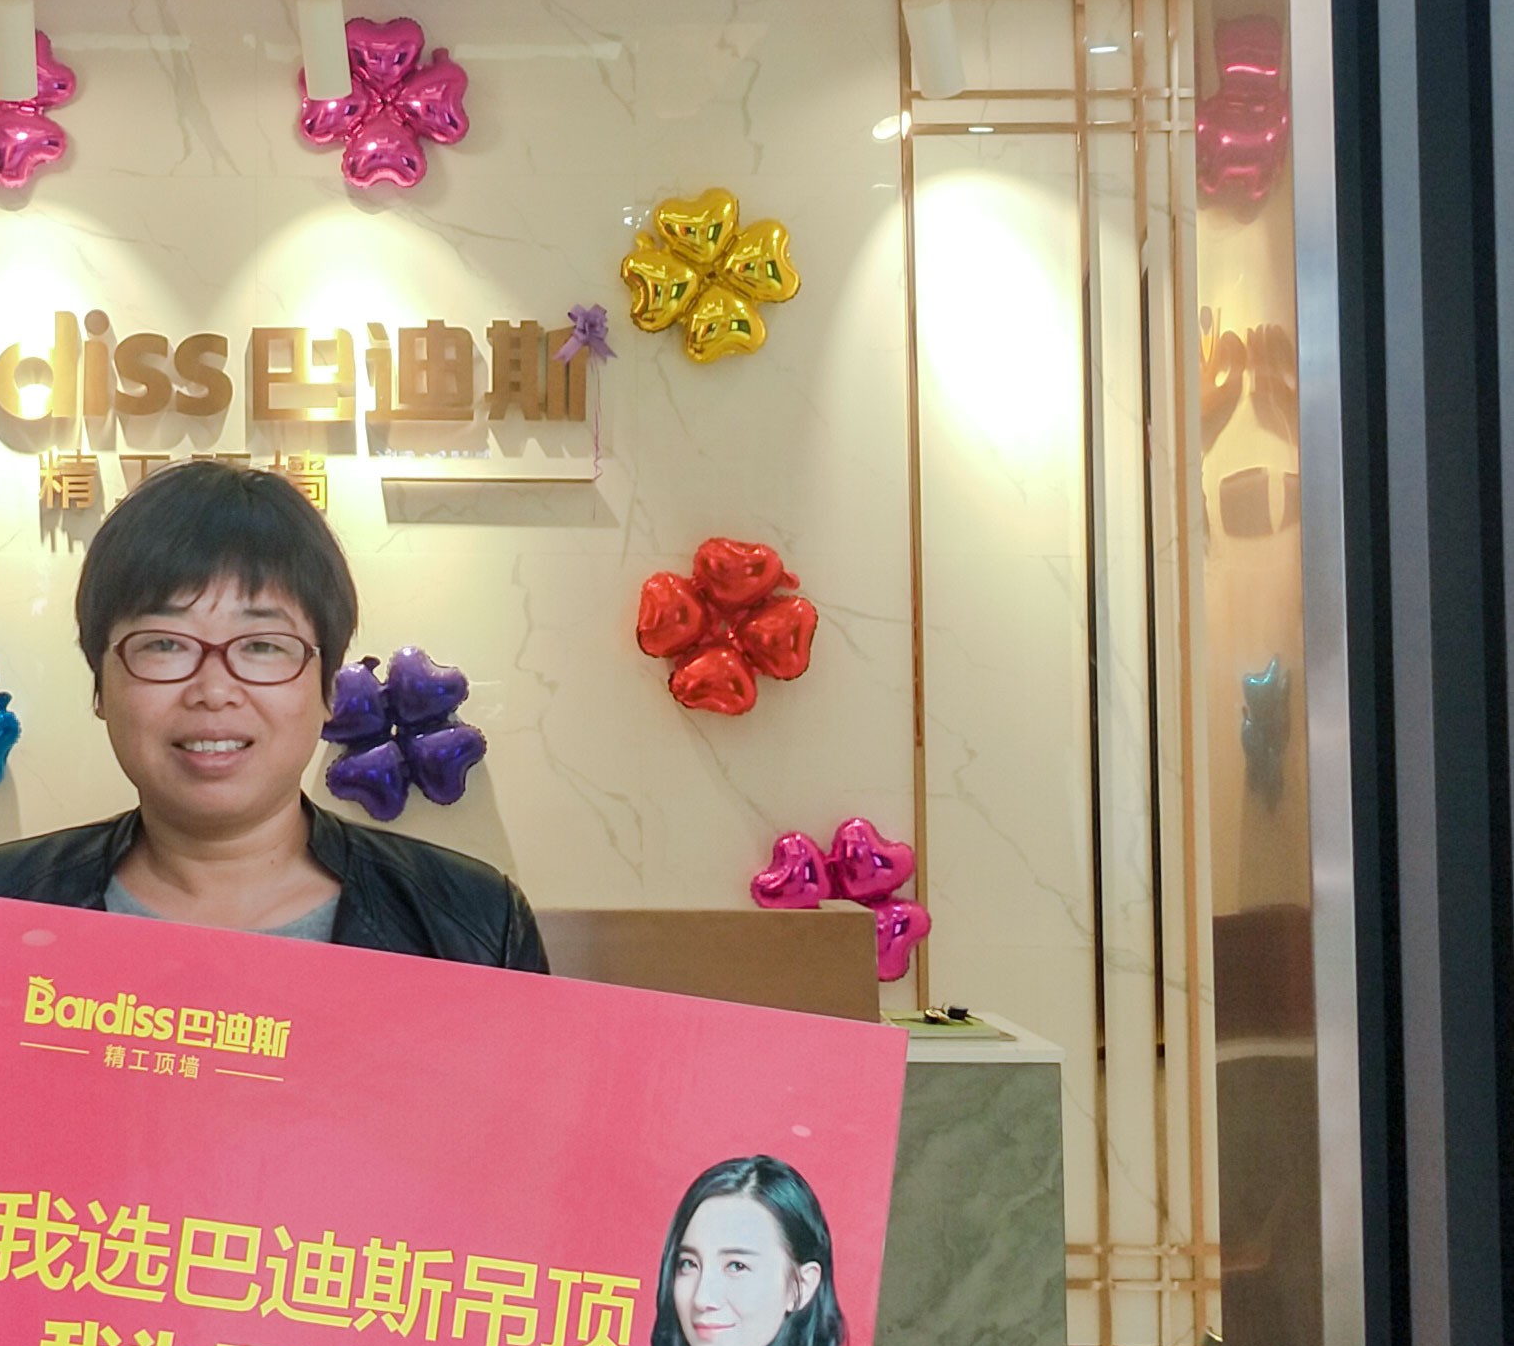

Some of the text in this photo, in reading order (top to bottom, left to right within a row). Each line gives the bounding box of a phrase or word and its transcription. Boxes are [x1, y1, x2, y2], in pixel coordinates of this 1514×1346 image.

[251, 319, 587, 421] 巴迪斯
[24, 976, 291, 1058] Bardiss 巴迪斯
[103, 1044, 200, 1079] 精工顶墙
